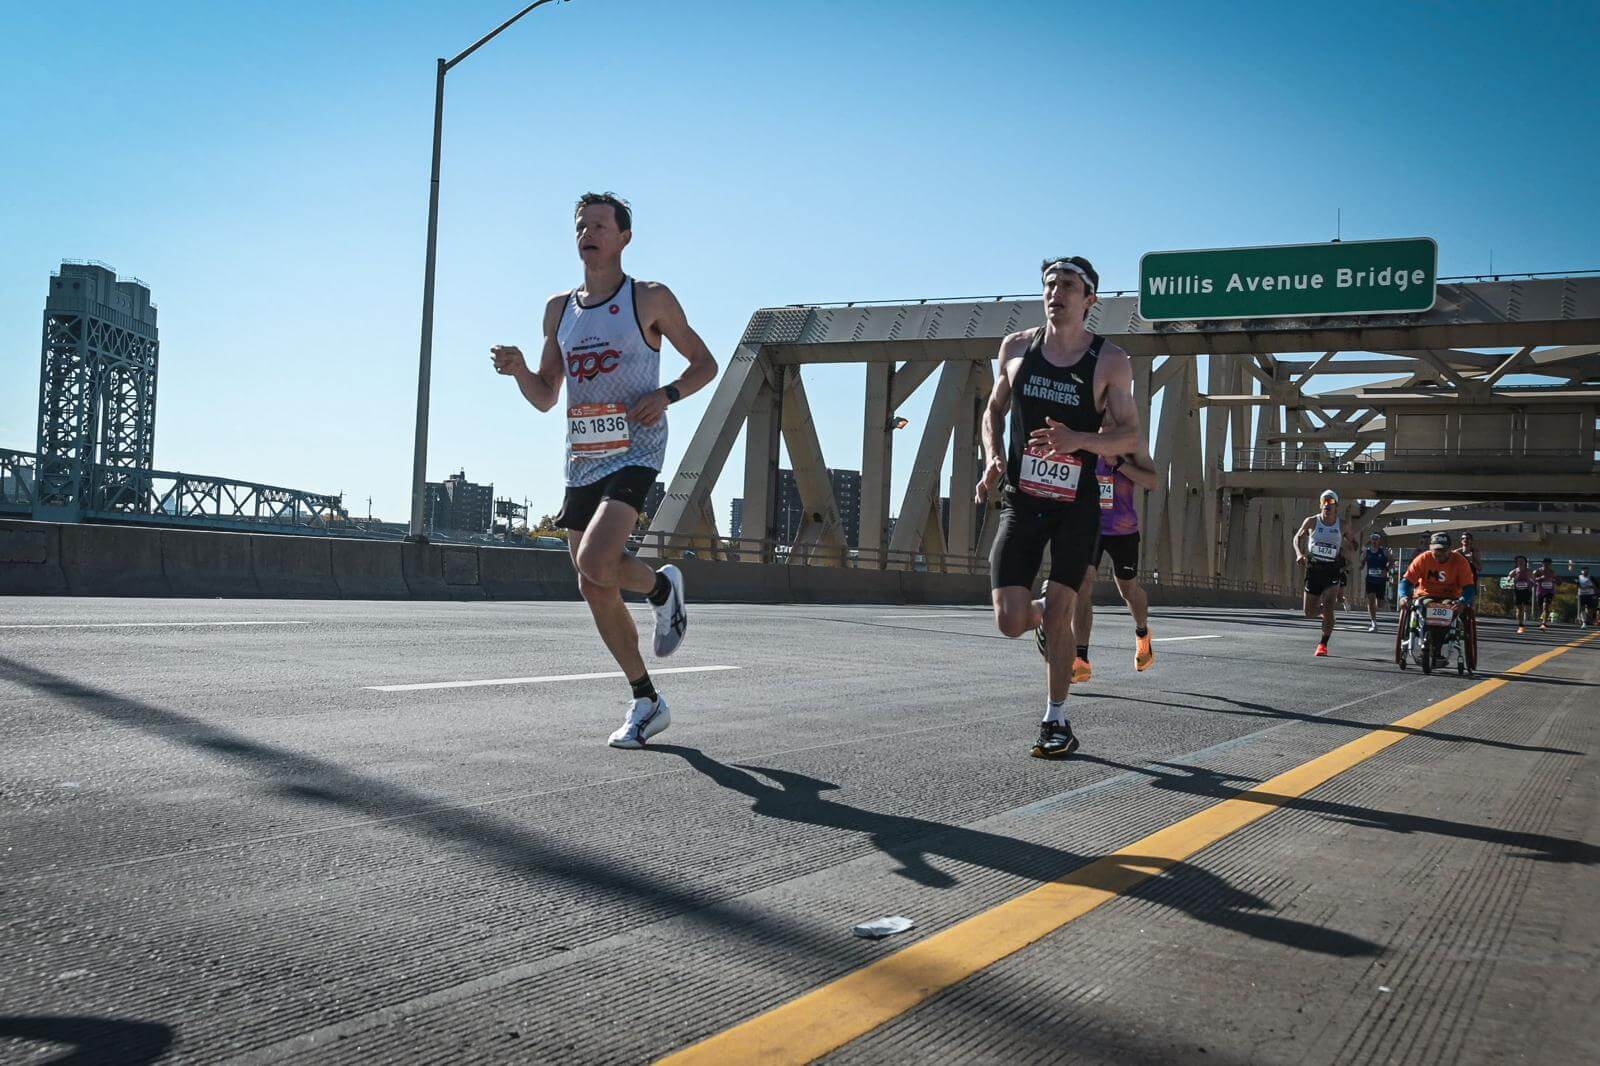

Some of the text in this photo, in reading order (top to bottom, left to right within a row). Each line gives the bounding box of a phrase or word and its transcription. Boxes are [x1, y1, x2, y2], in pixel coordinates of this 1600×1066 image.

[1148, 266, 1425, 296] Willis Avenue Bridge
[1023, 383, 1080, 406] HARRIERS
[1029, 374, 1077, 394] NEW YORK
[571, 416, 625, 434] AG 1836
[1031, 459, 1070, 481] 1049
[1432, 608, 1447, 616] 280
